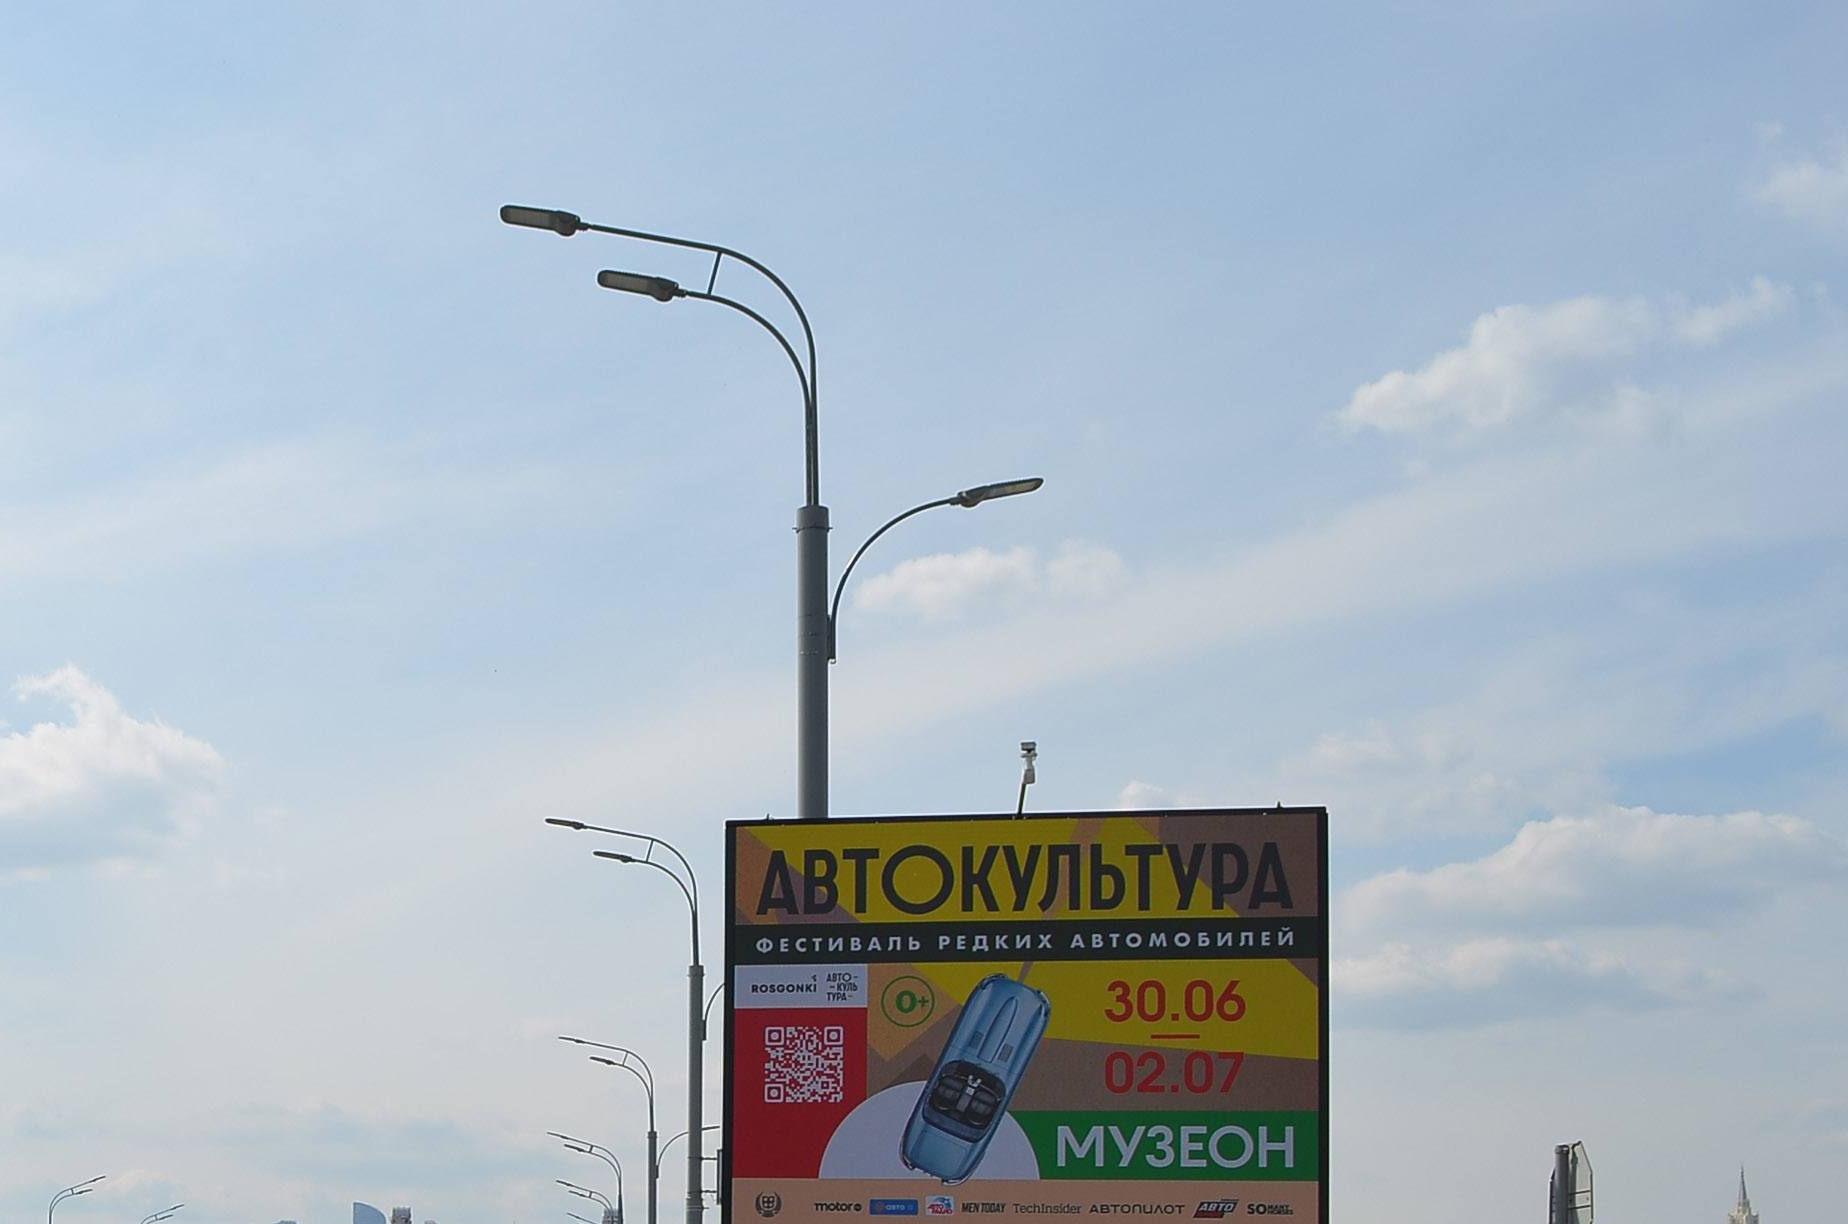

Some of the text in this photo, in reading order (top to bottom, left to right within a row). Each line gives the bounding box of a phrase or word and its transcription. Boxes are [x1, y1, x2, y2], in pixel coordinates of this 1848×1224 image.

[756, 842, 1294, 916] АВТОКУЛЬТУРА
[755, 926, 1296, 954] ФЕСТИВАЛЬ РЕДКИХ АВТОМОБИЛЕЙ
[750, 982, 818, 995] ROSGONKI
[895, 989, 930, 1014] 0+
[1104, 979, 1247, 1023] 30.06
[1104, 1051, 1246, 1094] 02.07
[1056, 1124, 1295, 1169] МУЗЕОН
[961, 1202, 1006, 1213] MEN TODAY
[1013, 1202, 1082, 1214] TechInsider
[1247, 1203, 1267, 1215] SO
